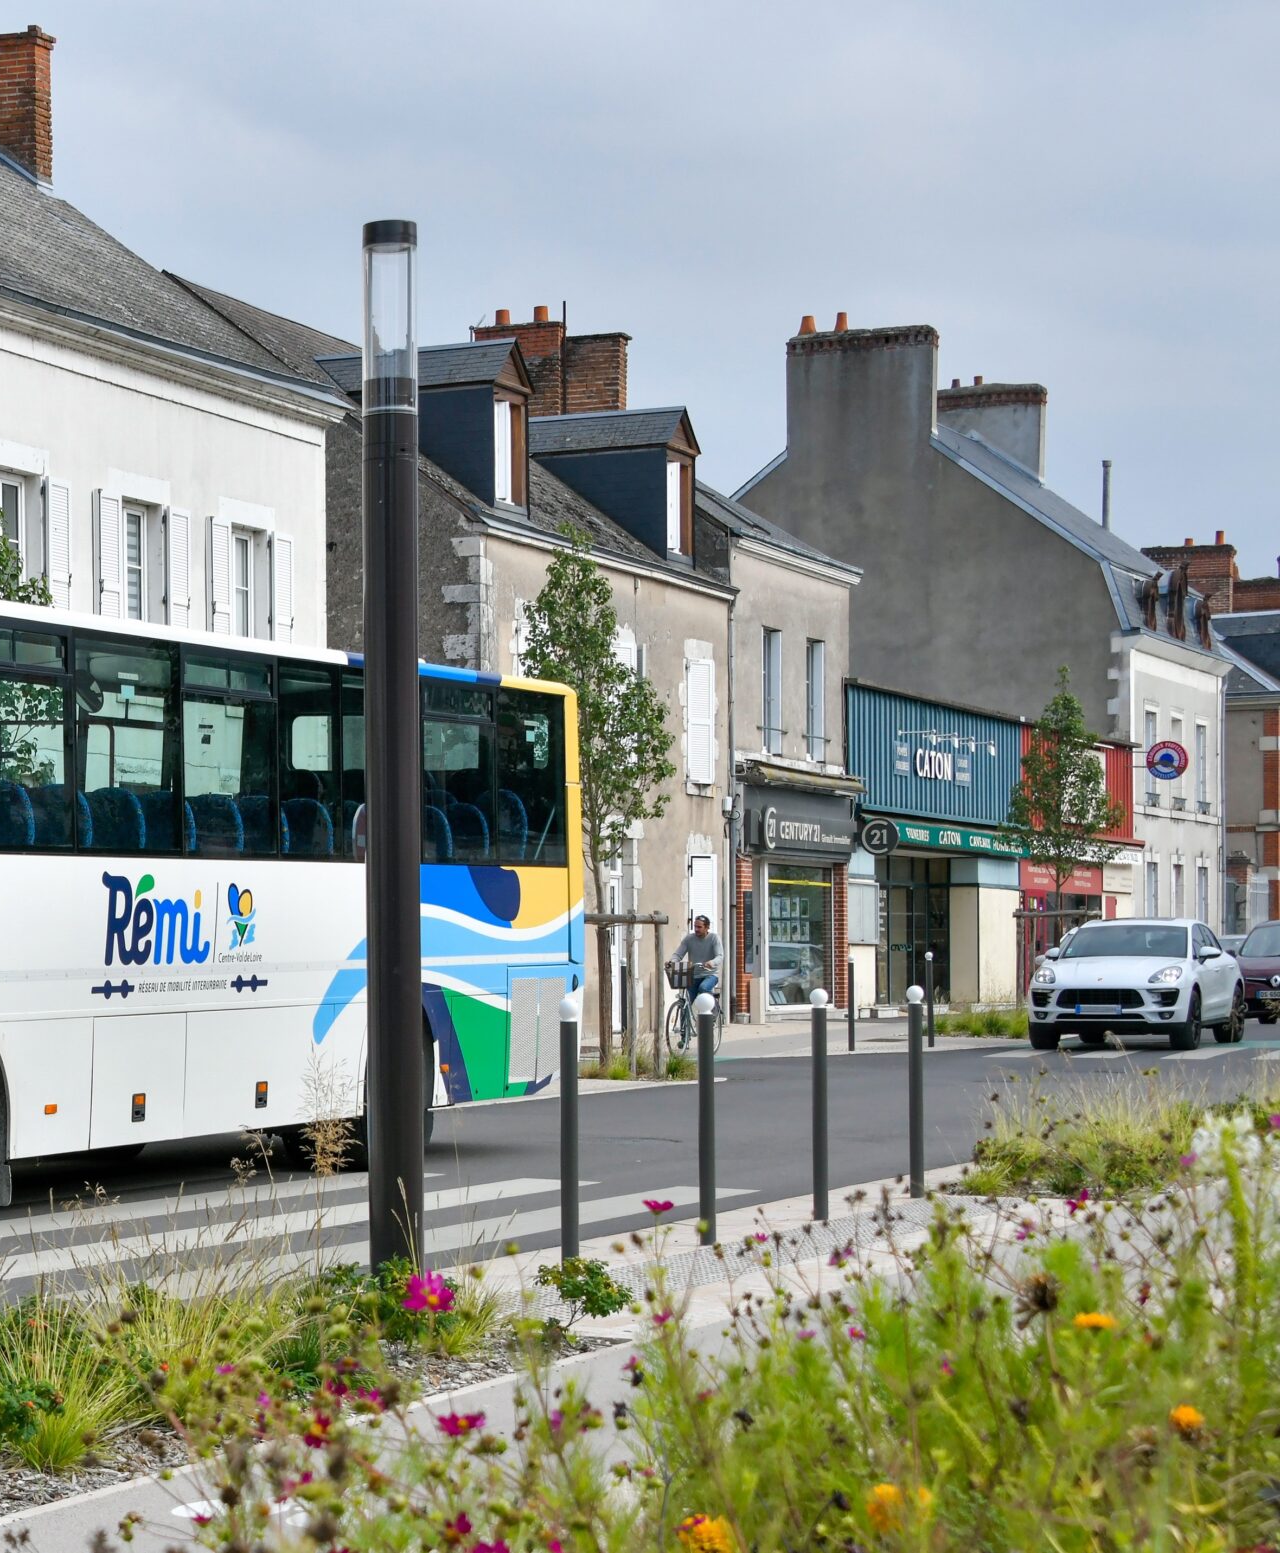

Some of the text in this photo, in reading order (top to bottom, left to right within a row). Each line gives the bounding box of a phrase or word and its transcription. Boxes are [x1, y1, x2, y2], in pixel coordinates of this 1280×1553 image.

[916, 748, 952, 781] CATON
[780, 821, 813, 842] CENTURY
[813, 824, 821, 843] 21
[939, 830, 962, 846] CATON
[969, 835, 992, 850] CAVEAUX
[102, 871, 210, 967] Rémi
[138, 978, 228, 994] RÉSEAU DE MOBILITÉ INTERURBAINE
